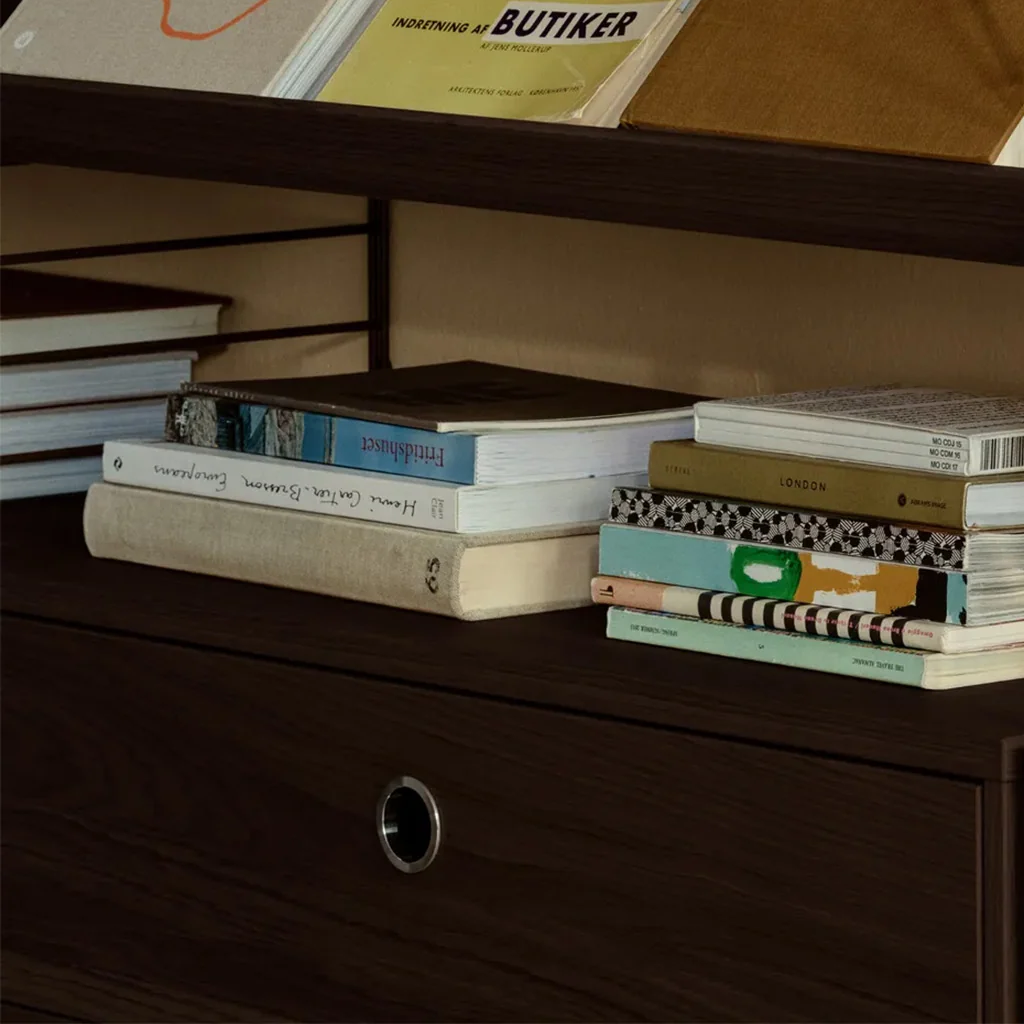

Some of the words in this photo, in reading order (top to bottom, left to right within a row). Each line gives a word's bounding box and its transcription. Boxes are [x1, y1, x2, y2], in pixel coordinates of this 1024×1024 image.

[391, 16, 469, 34] INDRETNING
[470, 23, 490, 35] AF
[490, 7, 639, 39] BUTIKER
[489, 42, 510, 53] JENS
[360, 435, 446, 468] Fritidshuset
[929, 448, 940, 456] MO
[931, 436, 943, 446] MO
[930, 461, 941, 469] MO
[153, 464, 228, 493] Europeans
[779, 476, 828, 493] LONDON
[369, 495, 417, 517] Henri
[430, 497, 439, 520] Clair
[437, 497, 445, 520] Jean
